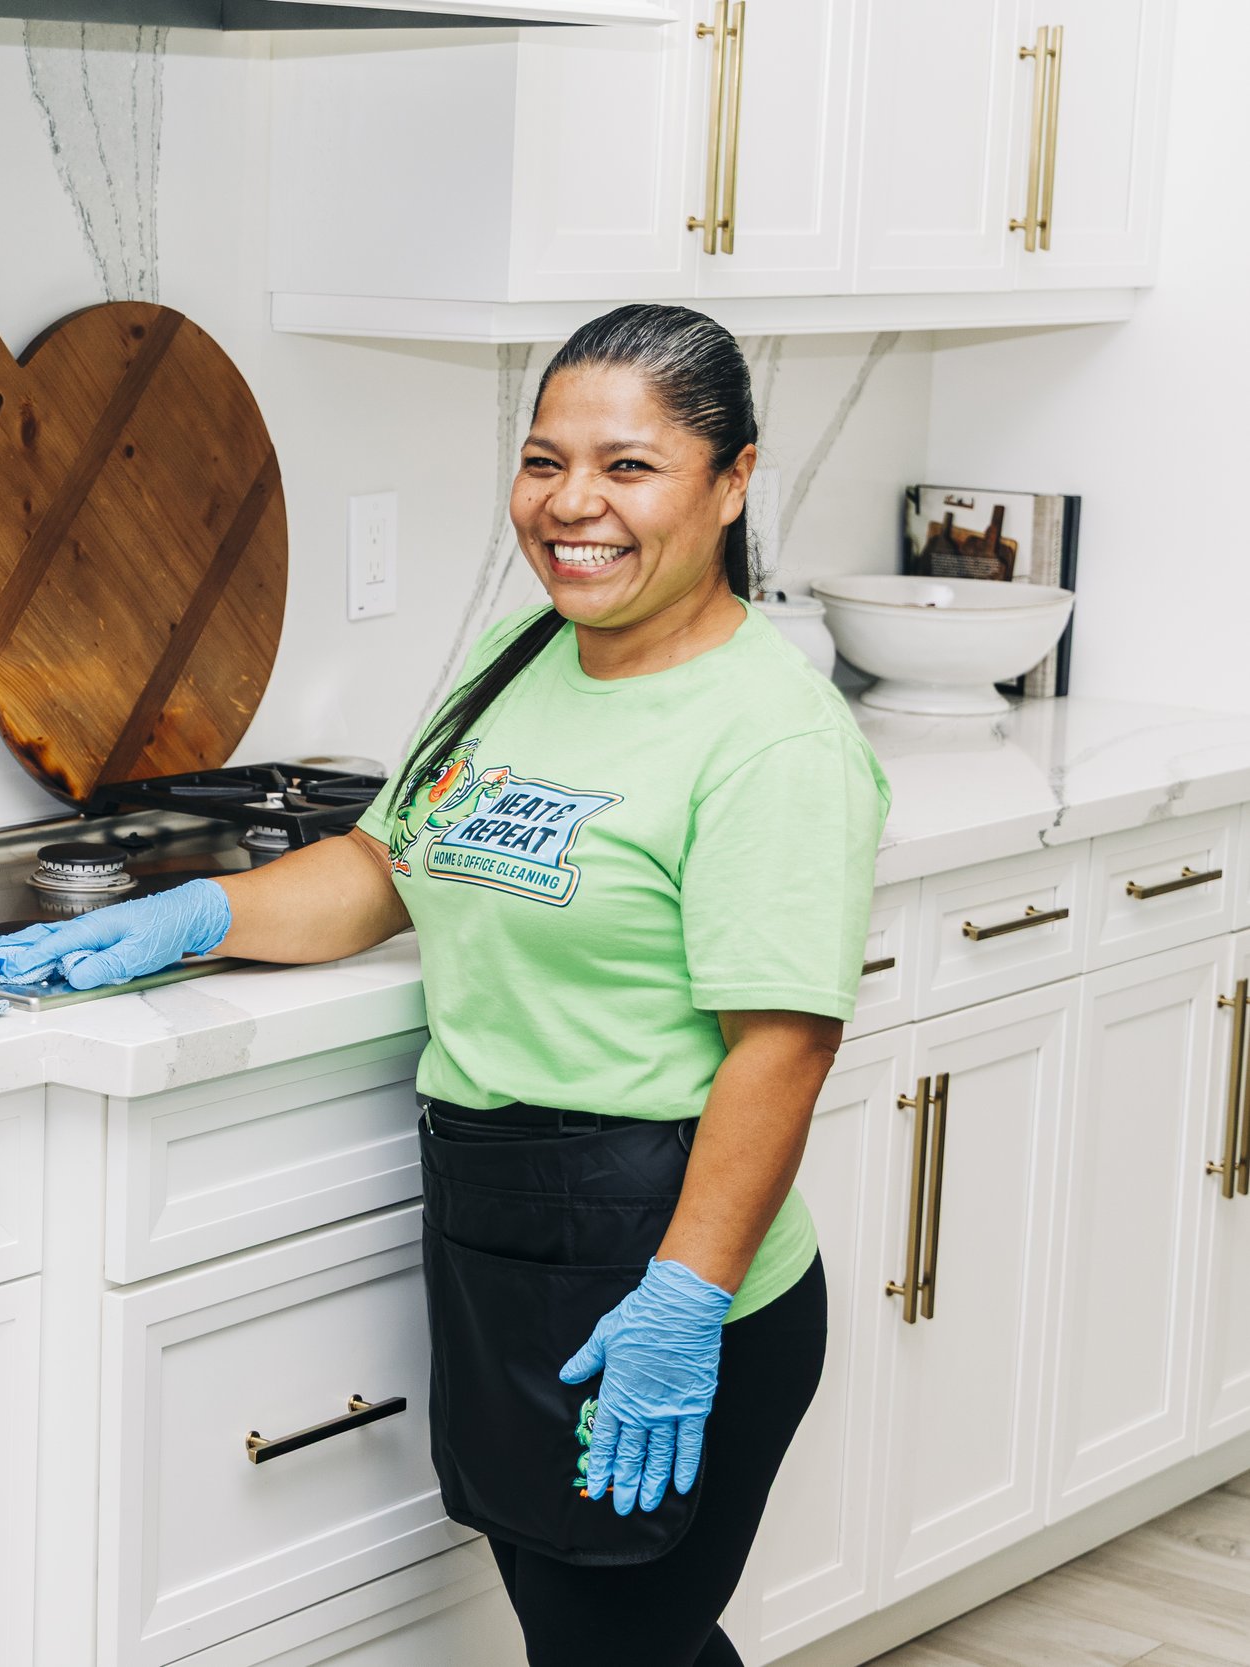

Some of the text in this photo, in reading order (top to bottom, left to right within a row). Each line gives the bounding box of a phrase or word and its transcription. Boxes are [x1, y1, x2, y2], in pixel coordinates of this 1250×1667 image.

[488, 793, 561, 821] NEAT
[458, 818, 557, 854] REPEAT
[433, 851, 560, 889] HOME & OFFICE CLEANING
